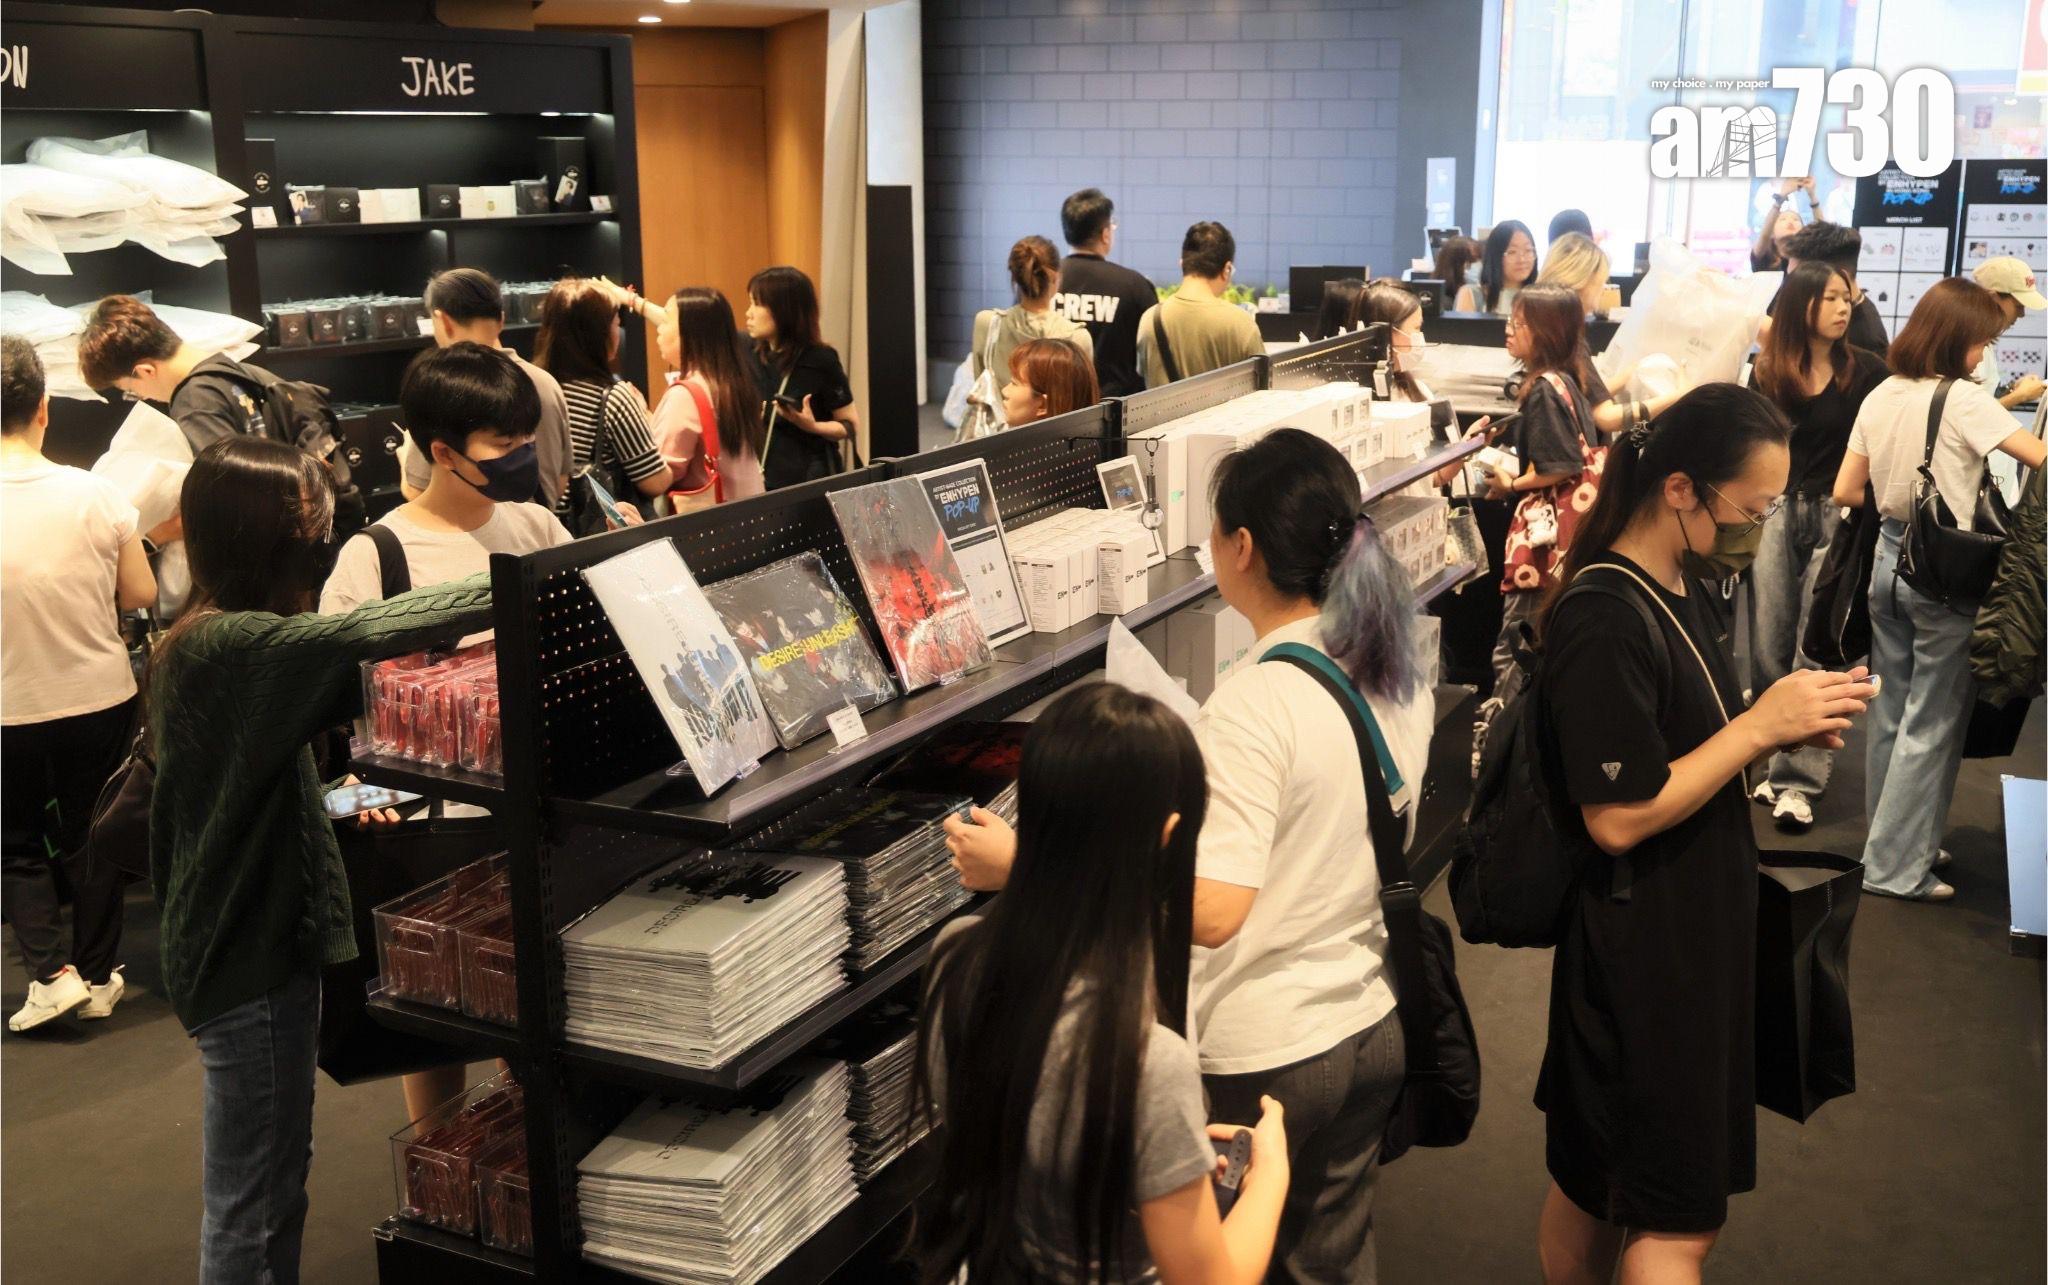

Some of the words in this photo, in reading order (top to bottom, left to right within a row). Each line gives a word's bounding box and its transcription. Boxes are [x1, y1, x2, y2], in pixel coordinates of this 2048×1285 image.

[401, 56, 474, 96] JAKE
[1051, 293, 1120, 323] CREW
[940, 483, 980, 505] ENHYPEN
[943, 496, 980, 521] POP-UP
